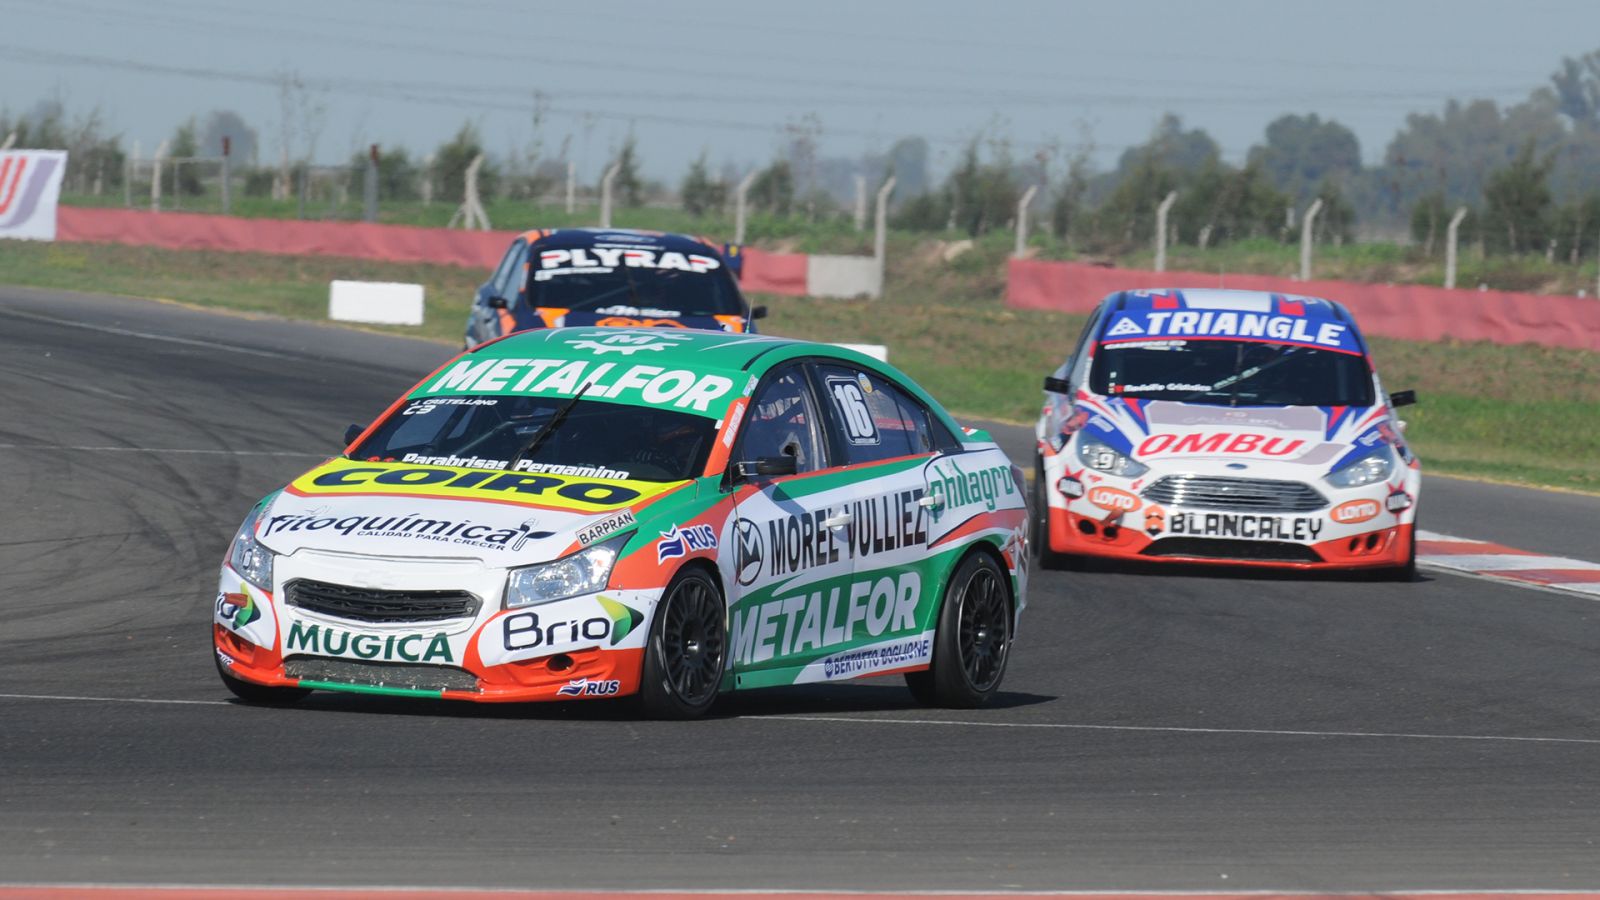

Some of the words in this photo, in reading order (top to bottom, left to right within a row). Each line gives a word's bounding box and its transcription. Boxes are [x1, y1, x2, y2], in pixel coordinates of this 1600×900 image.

[540, 248, 720, 273] PLYRAP
[1146, 311, 1346, 347] TRIANGLE
[426, 358, 734, 413] METALFOR
[402, 405, 436, 416] C3
[422, 398, 498, 406] CASTELLANO
[834, 384, 874, 437] 16
[1098, 452, 1115, 469] 9
[1137, 433, 1306, 457] OMBU
[402, 452, 509, 471] Parabrisas
[513, 459, 630, 480] Pergamino
[312, 467, 642, 505] COIRO
[929, 459, 1013, 524] philagro
[264, 513, 517, 545] fitoquímica
[357, 529, 415, 540] CALIDAD
[415, 533, 449, 543] PARA
[453, 537, 505, 551] CRECER
[579, 512, 634, 545] BARPRAN
[681, 525, 718, 550] RUS
[769, 507, 839, 577] MOREL
[844, 488, 926, 560] VULLIEZ
[1170, 512, 1323, 540] BLANCALEY
[503, 611, 610, 651] Brio
[727, 571, 921, 668] METALFOR
[287, 619, 454, 662] MUGICA
[834, 649, 880, 676] BERTOTTO
[880, 639, 929, 666] BOGLIONE
[585, 680, 620, 695] RUS
